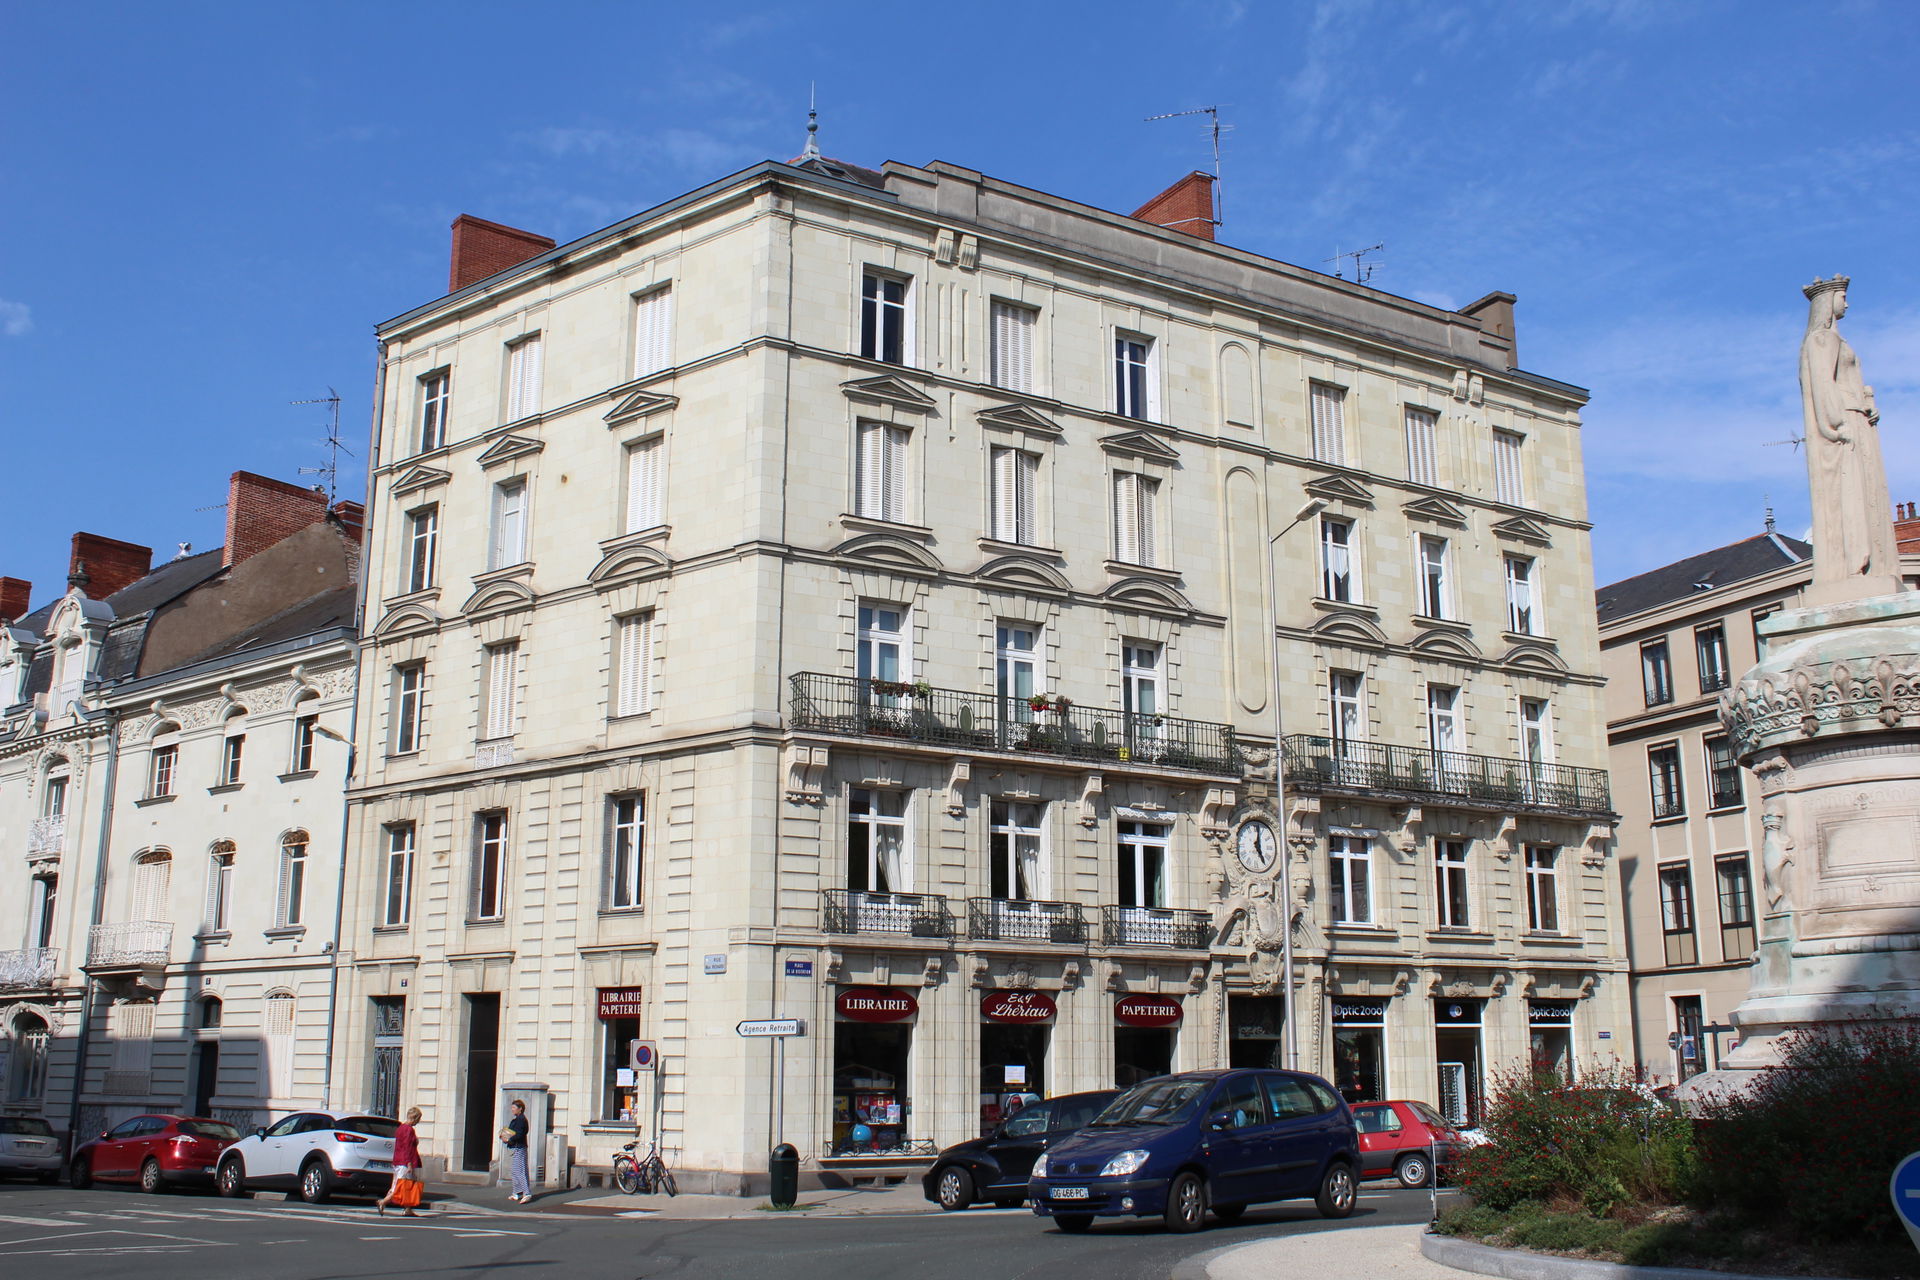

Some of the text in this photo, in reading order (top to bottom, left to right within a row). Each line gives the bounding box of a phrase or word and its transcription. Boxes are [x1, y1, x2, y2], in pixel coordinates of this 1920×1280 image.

[602, 992, 641, 1002] LIBRAIRIE
[601, 1005, 641, 1015] PAPETERIE
[846, 999, 909, 1011] LIBRAIRIE
[991, 1003, 1049, 1017] Lhériau
[1122, 1005, 1177, 1016] PAPETERIE
[744, 1024, 796, 1034] Agence Retraite
